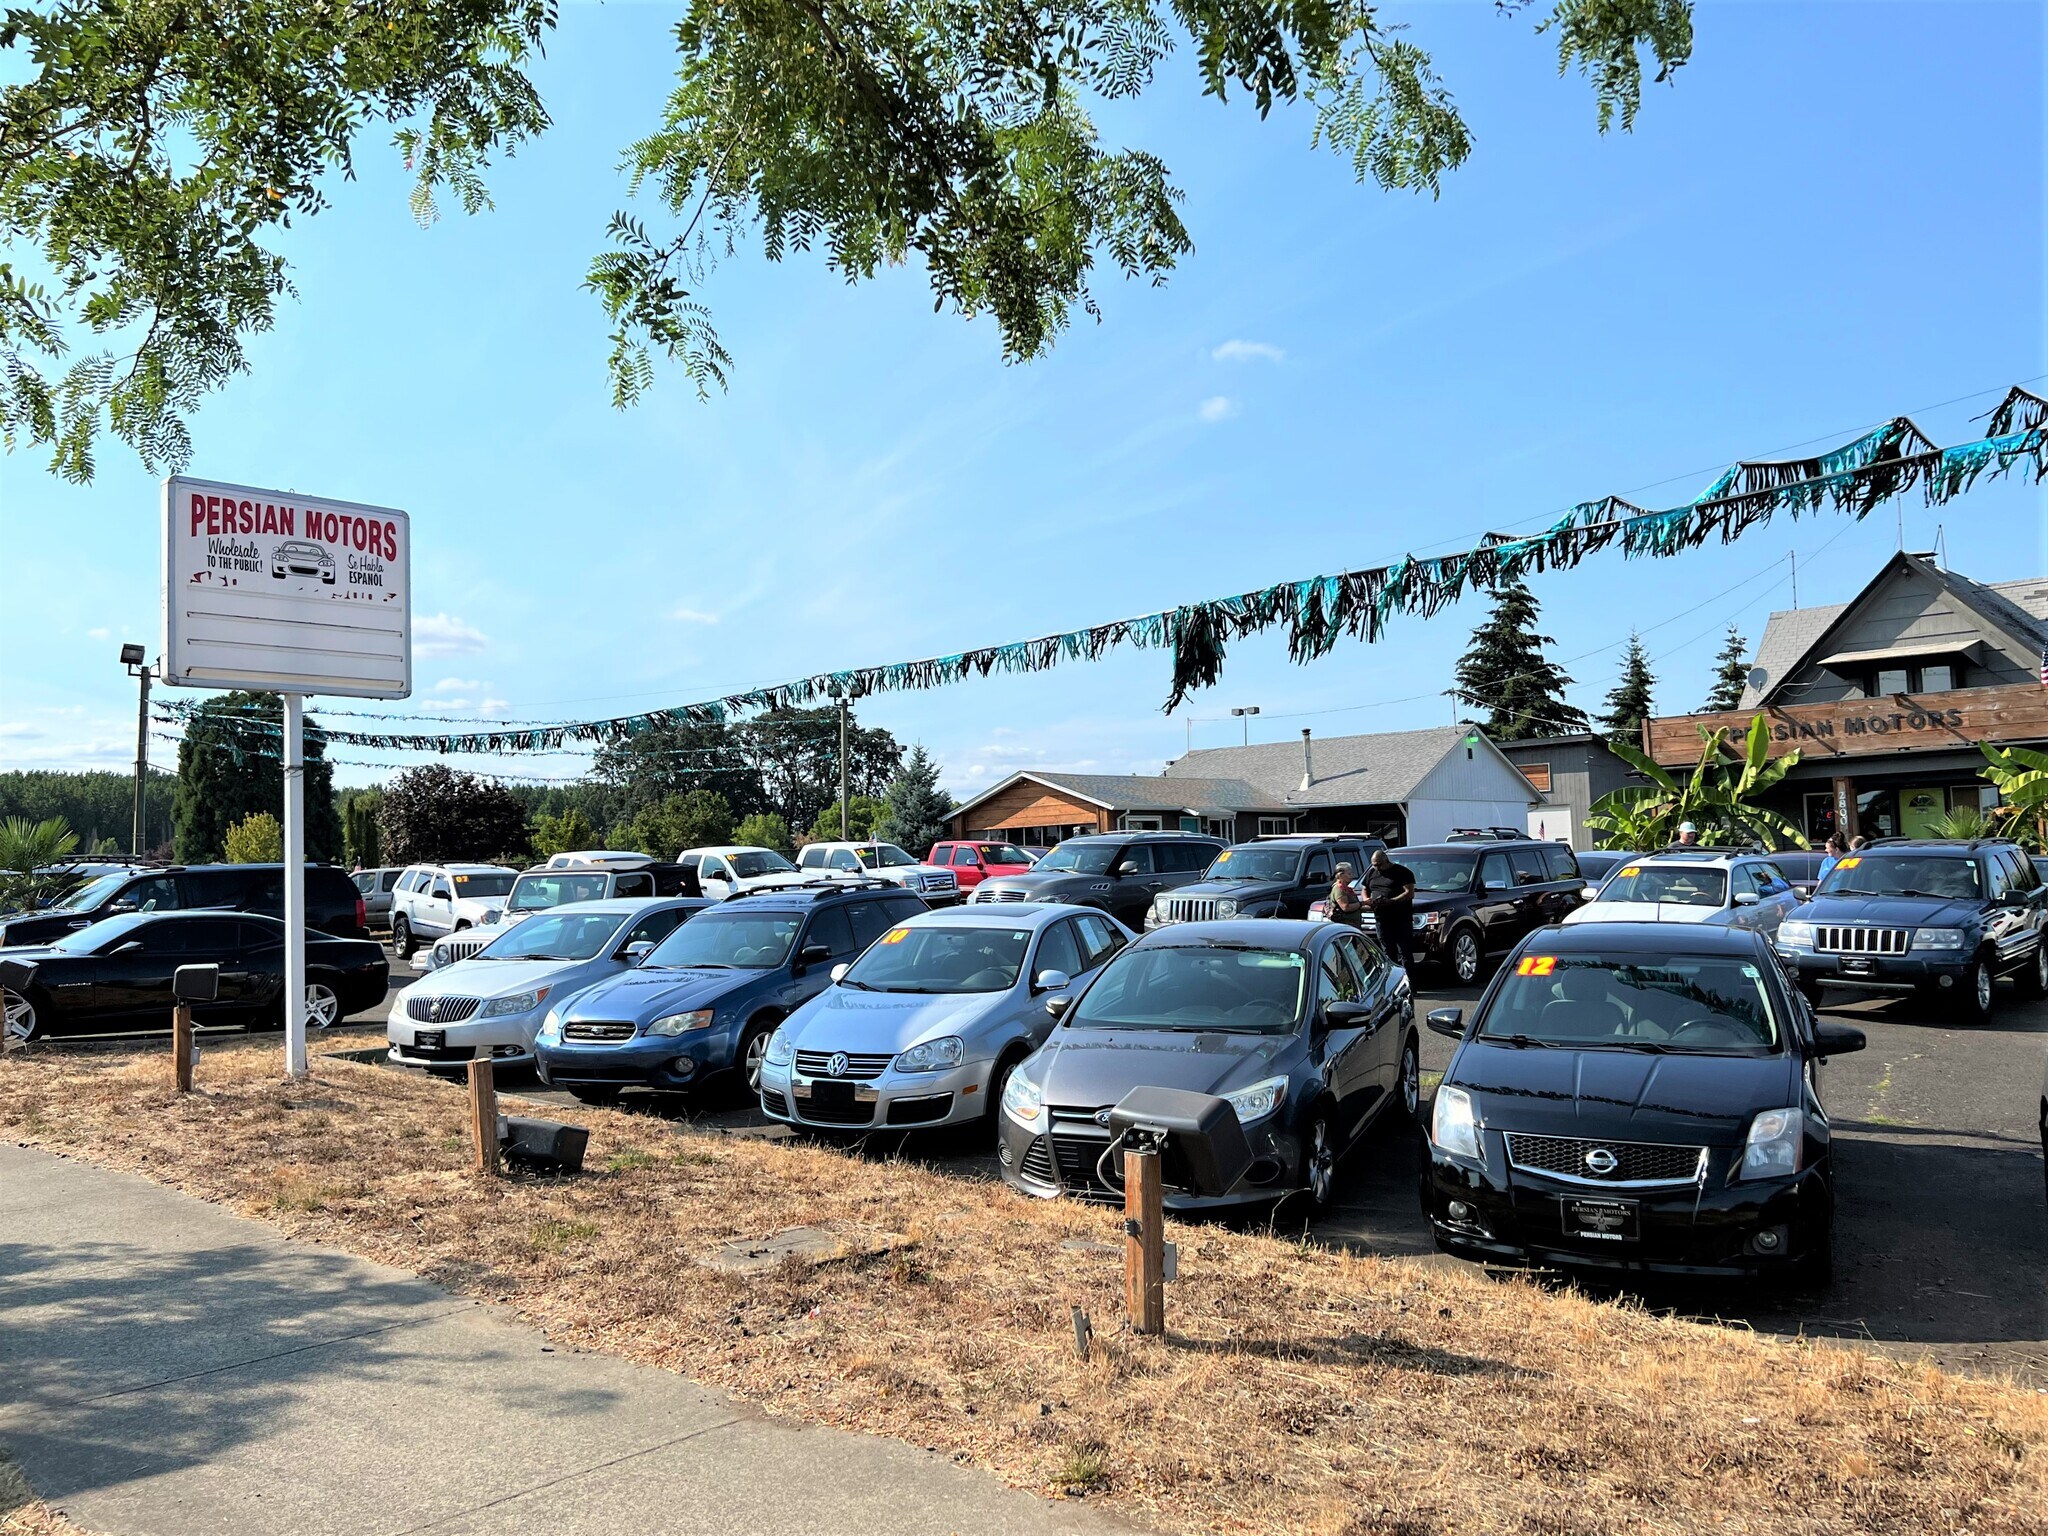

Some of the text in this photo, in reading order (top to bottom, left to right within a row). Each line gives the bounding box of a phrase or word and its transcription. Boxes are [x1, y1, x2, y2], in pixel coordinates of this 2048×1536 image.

[191, 494, 397, 562] PERSIAN MOTORS
[208, 537, 260, 559] Wholesale
[207, 555, 263, 573] TO THE PUBLIC!
[347, 553, 384, 572] Se Habla
[349, 570, 383, 587] ESPANOL
[1729, 708, 1963, 744] PSIAN MOTORS
[1838, 791, 1848, 825] 2800
[882, 928, 910, 944] 10
[1517, 956, 1556, 975] 12
[1603, 1208, 1631, 1216] MOTORS
[1580, 1231, 1623, 1241] PERSIAN MOTORS
